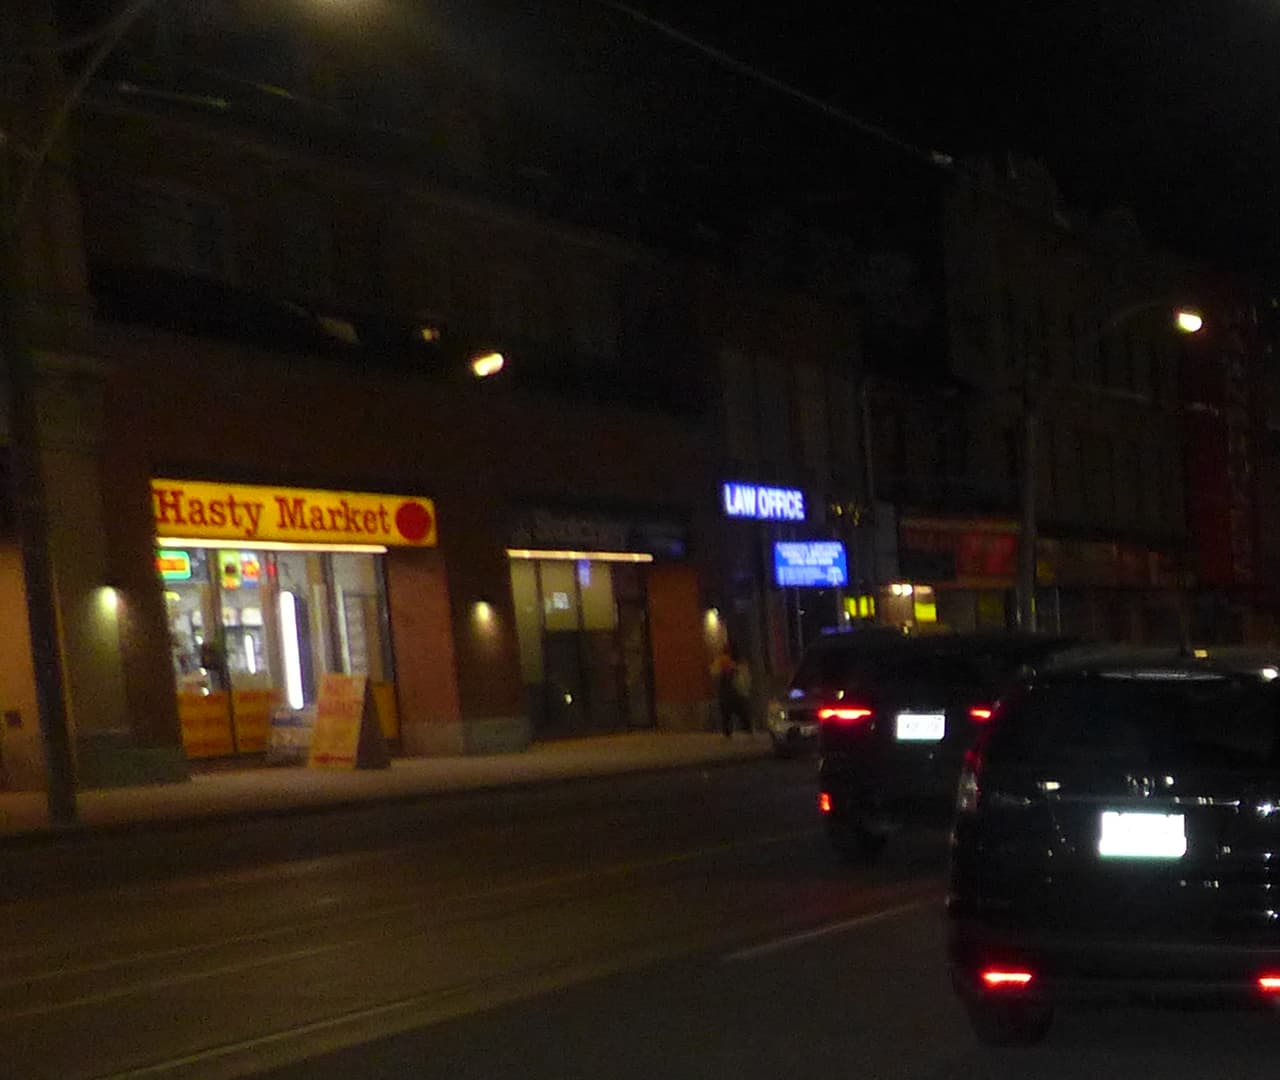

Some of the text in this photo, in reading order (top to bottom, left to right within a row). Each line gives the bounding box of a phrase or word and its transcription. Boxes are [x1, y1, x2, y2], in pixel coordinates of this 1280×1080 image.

[154, 489, 391, 537] Hasty Market
[724, 483, 805, 520] LAW OFFICE
